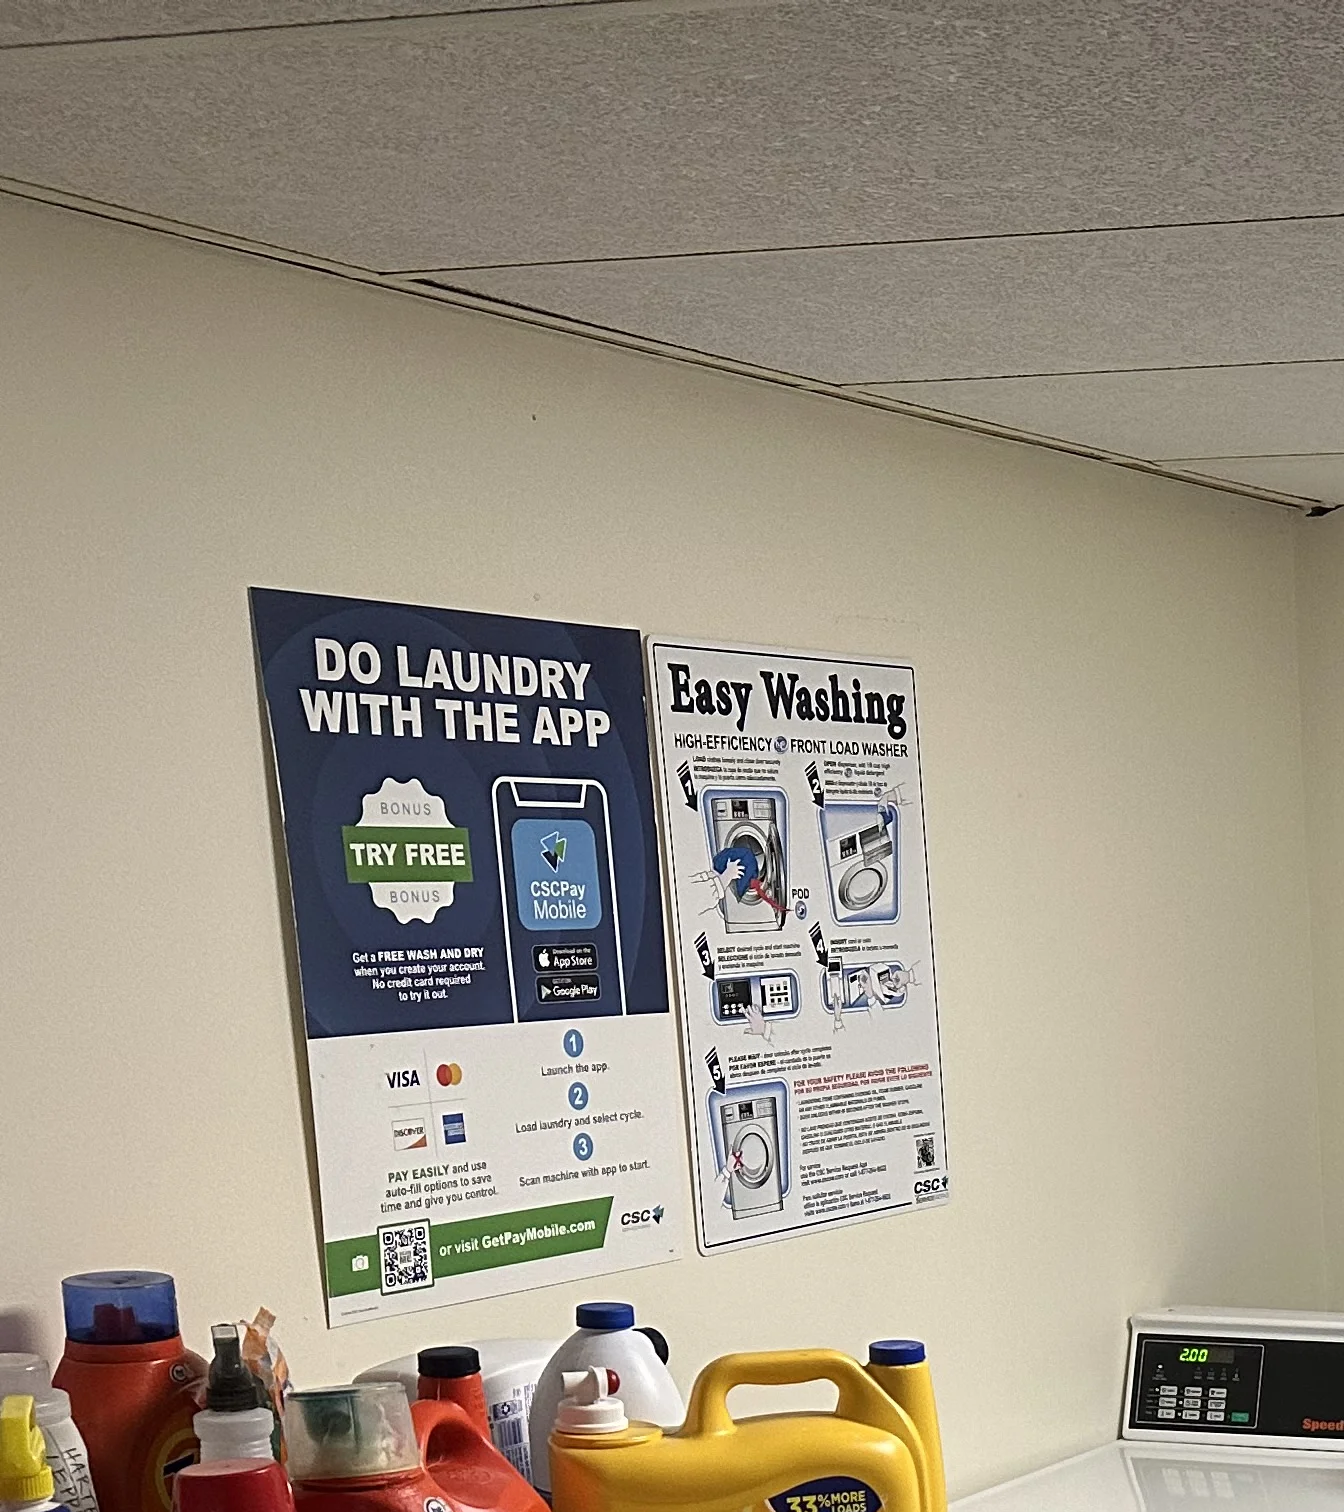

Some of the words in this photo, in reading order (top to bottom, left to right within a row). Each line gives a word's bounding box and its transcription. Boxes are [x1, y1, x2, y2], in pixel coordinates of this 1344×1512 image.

[314, 637, 382, 685] DO
[396, 645, 592, 701] LAUNDRY
[667, 662, 753, 732] Easy
[759, 670, 907, 740] Washing
[298, 688, 423, 738] WITH
[435, 698, 521, 743] THE
[532, 705, 611, 748] APP
[674, 732, 772, 752] HIGH-EFFICIENCY
[790, 738, 826, 754] FRONT
[830, 740, 860, 756] LOAD
[862, 742, 908, 758] WASHER
[685, 780, 694, 797] 1
[812, 778, 821, 795] 2
[380, 801, 432, 816] BONUS
[349, 843, 398, 866] TRY
[404, 843, 466, 866] FREE
[389, 889, 441, 904] BONUS
[530, 880, 586, 897] CSCPay
[792, 888, 810, 899] POD
[534, 899, 587, 919] Mobile
[816, 938, 825, 953] 4
[352, 951, 369, 963] Get
[370, 953, 376, 962] a
[377, 950, 405, 963] FREE
[406, 948, 437, 961] WASH
[439, 947, 462, 960] AND
[463, 947, 484, 959] DRY
[553, 955, 569, 968] App
[570, 955, 592, 967] Store
[702, 950, 711, 966] 3
[354, 966, 378, 977] when
[380, 966, 398, 977] you
[398, 963, 426, 975] create
[427, 963, 448, 976] your
[449, 961, 486, 972] account.
[372, 978, 386, 989] No
[387, 976, 413, 988] credit
[414, 975, 434, 987] card
[435, 974, 471, 987] required
[399, 991, 408, 1001] to
[409, 990, 422, 1003] try
[423, 989, 430, 999] it
[431, 988, 448, 1000] out.
[552, 985, 580, 998] Google
[581, 984, 598, 998] Play
[569, 1036, 577, 1051] 1
[541, 1064, 573, 1077] Launch
[575, 1063, 589, 1073] the
[591, 1062, 610, 1074] app.
[712, 1065, 721, 1080] 5
[386, 1069, 420, 1088] VISA
[823, 1074, 844, 1085] SAFETY
[574, 1087, 583, 1104] 2
[515, 1121, 538, 1133] Load
[539, 1118, 573, 1132] laundry
[575, 1115, 591, 1127] and
[593, 1112, 618, 1125] select
[619, 1109, 645, 1123] cycle.
[394, 1126, 425, 1138] DISCOVER
[578, 1138, 588, 1155] 3
[388, 1170, 408, 1183] PAY
[412, 1164, 450, 1181] EASILY
[452, 1163, 469, 1174] and
[471, 1161, 487, 1171] use
[519, 1175, 541, 1187] Scan
[543, 1171, 580, 1184] machine
[581, 1167, 599, 1178] with
[601, 1164, 617, 1178] app
[619, 1162, 627, 1172] to
[629, 1160, 650, 1172] start.
[386, 1182, 422, 1199] auto-fill
[424, 1179, 459, 1195] options
[460, 1177, 470, 1187] to
[471, 1175, 492, 1185] save
[914, 1178, 940, 1194] CSC
[380, 1201, 402, 1213] time
[404, 1197, 422, 1209] and
[425, 1194, 444, 1208] give
[446, 1192, 463, 1204] you
[465, 1186, 499, 1200] control.
[620, 1209, 651, 1226] CSC
[439, 1246, 452, 1257] or
[454, 1239, 479, 1254] visit
[481, 1218, 596, 1249] GetPayMobile.com
[1302, 1418, 1344, 1434] Speed
[831, 1490, 866, 1503] MORE
